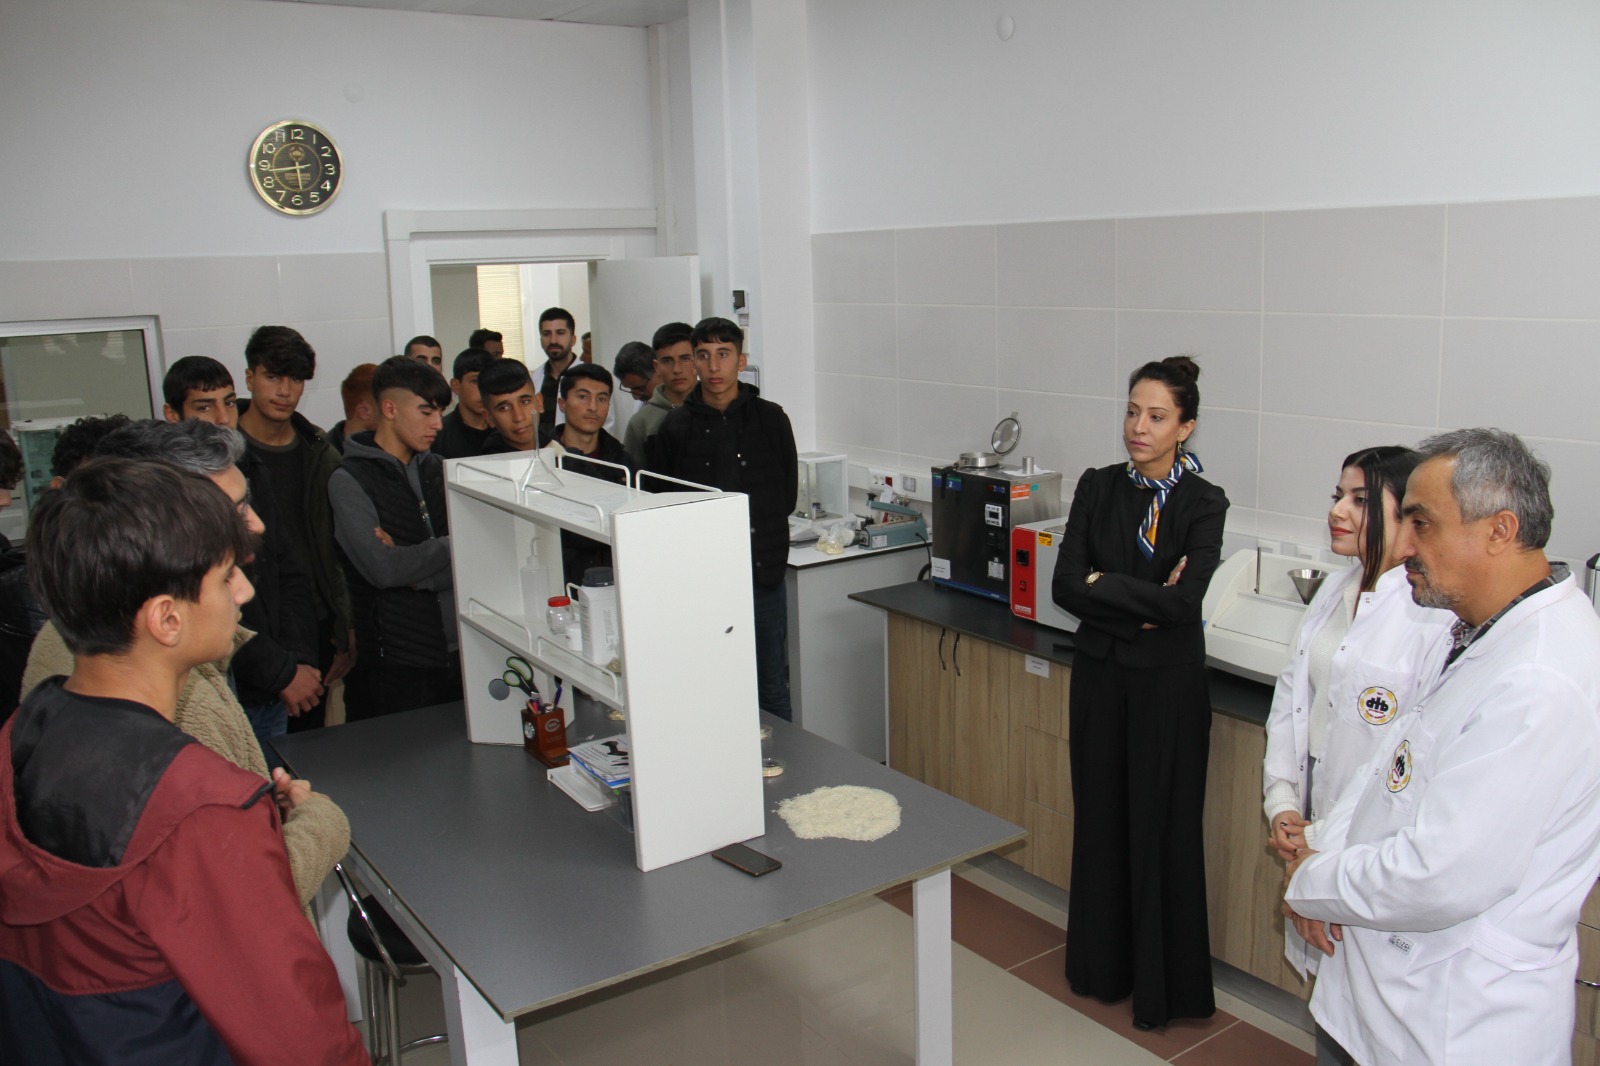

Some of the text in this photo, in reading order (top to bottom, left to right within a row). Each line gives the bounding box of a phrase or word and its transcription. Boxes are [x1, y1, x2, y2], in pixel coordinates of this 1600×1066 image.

[275, 130, 286, 143] 11
[291, 128, 304, 140] 12
[312, 133, 317, 145] 1
[262, 143, 276, 154] 10
[320, 146, 331, 157] 2
[258, 159, 271, 171] 9
[324, 163, 336, 175] 3
[263, 176, 275, 189] 8
[320, 180, 331, 191] 4
[275, 190, 286, 202] 7
[291, 194, 304, 206] 6
[309, 191, 320, 203] 5
